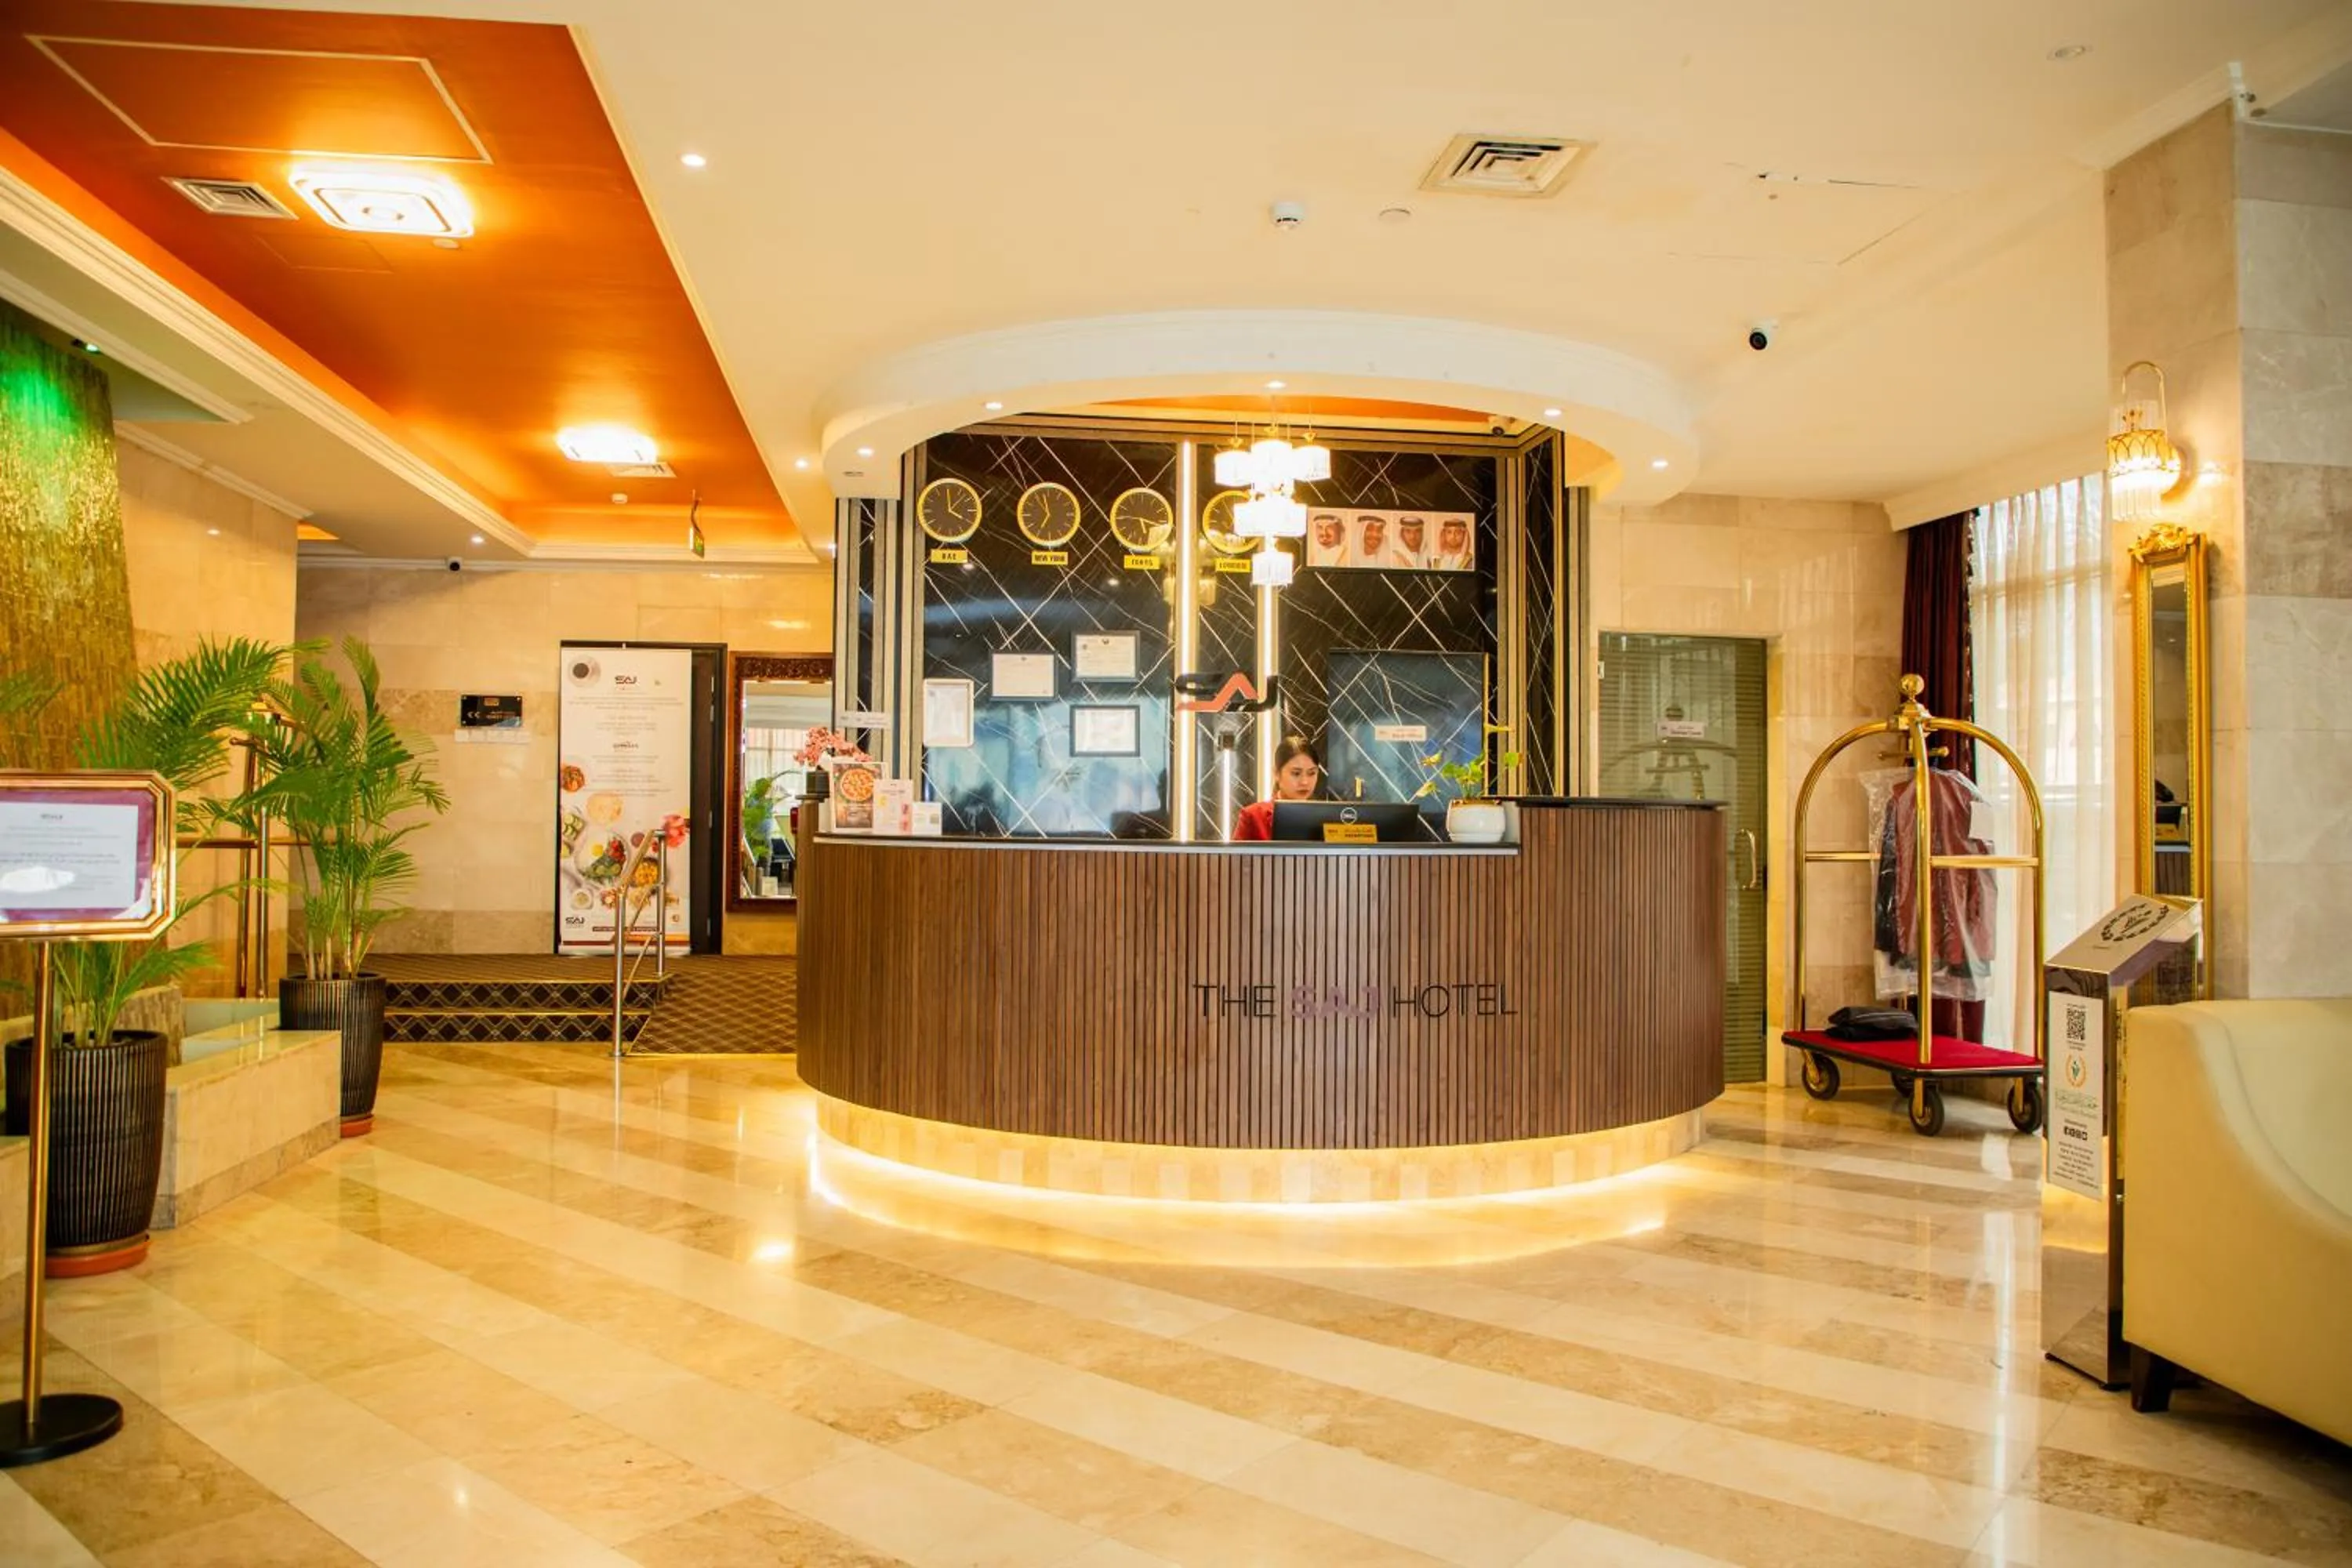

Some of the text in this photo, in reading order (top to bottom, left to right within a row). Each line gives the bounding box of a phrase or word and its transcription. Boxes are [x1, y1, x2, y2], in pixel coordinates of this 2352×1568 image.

[1192, 984, 1519, 1018] THE SAJ HOTEL
